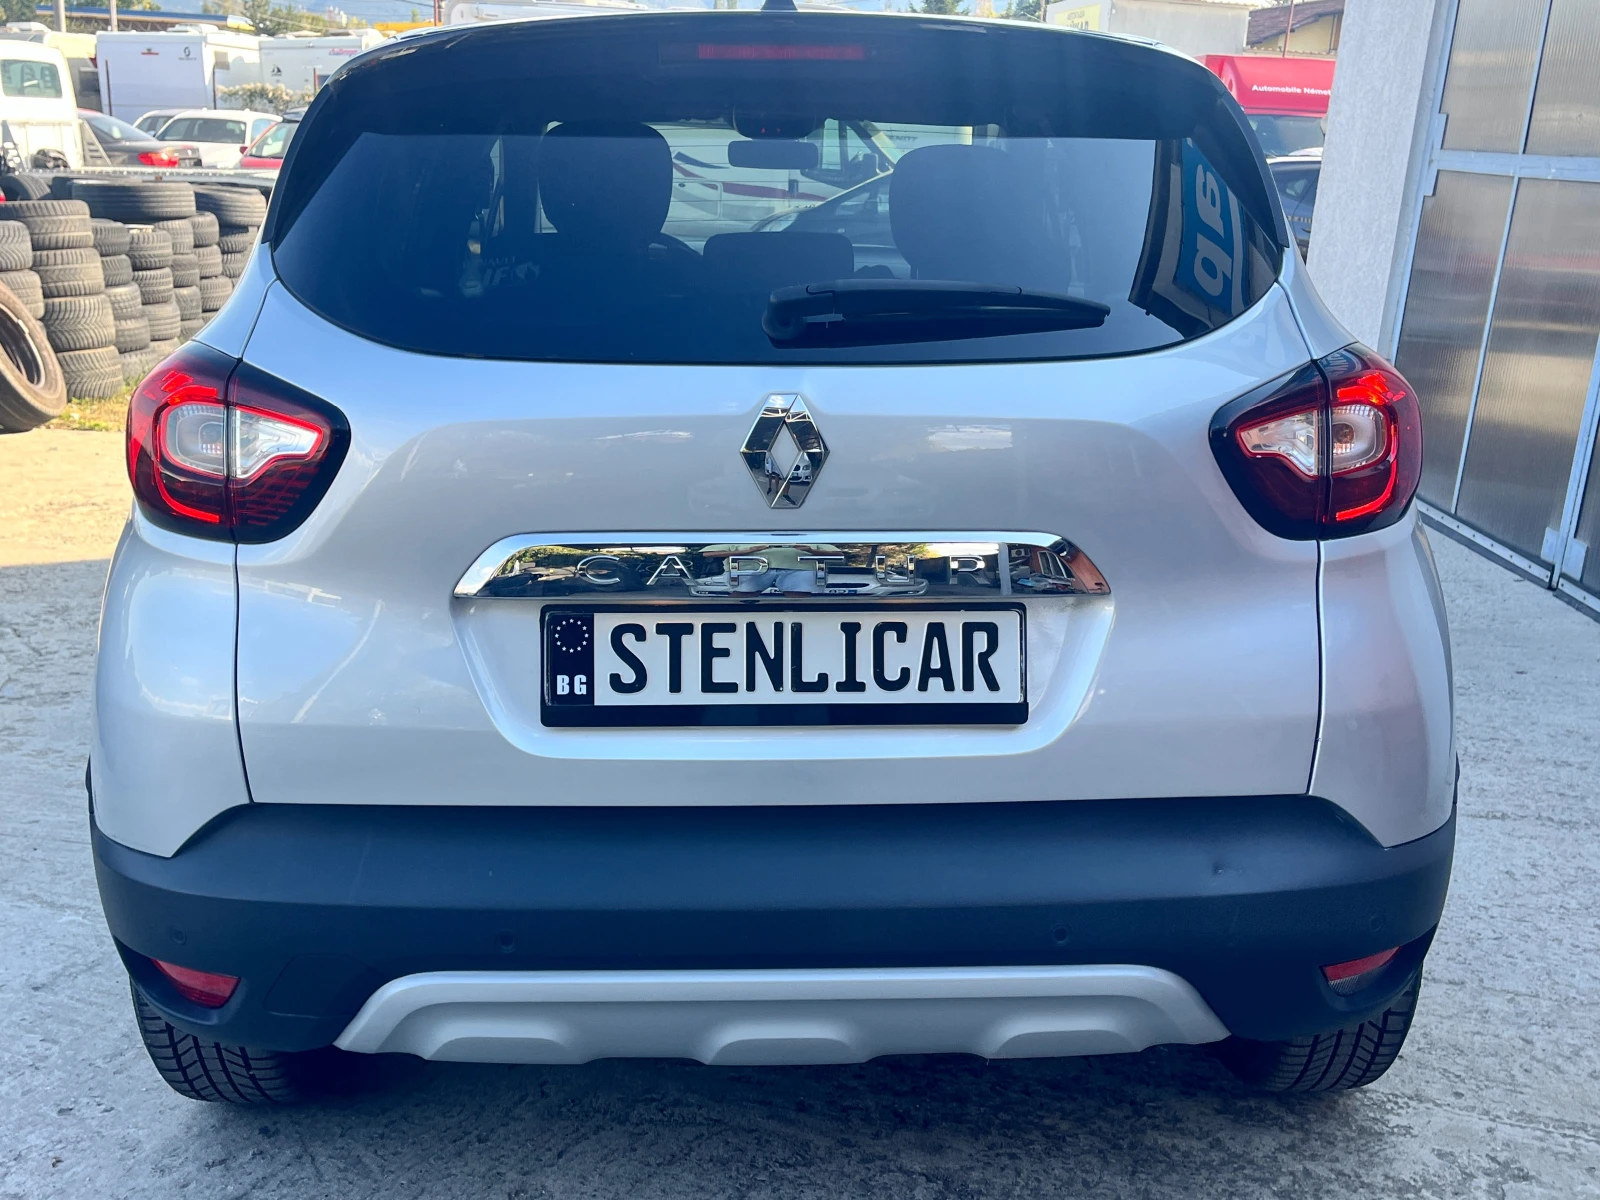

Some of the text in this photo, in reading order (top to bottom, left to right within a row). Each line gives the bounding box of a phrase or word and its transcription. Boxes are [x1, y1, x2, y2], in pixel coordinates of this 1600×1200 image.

[1252, 84, 1302, 94] Automobile
[576, 555, 992, 587] CAPTUR
[609, 621, 1000, 694] STENLICAR
[556, 674, 587, 695] BG
